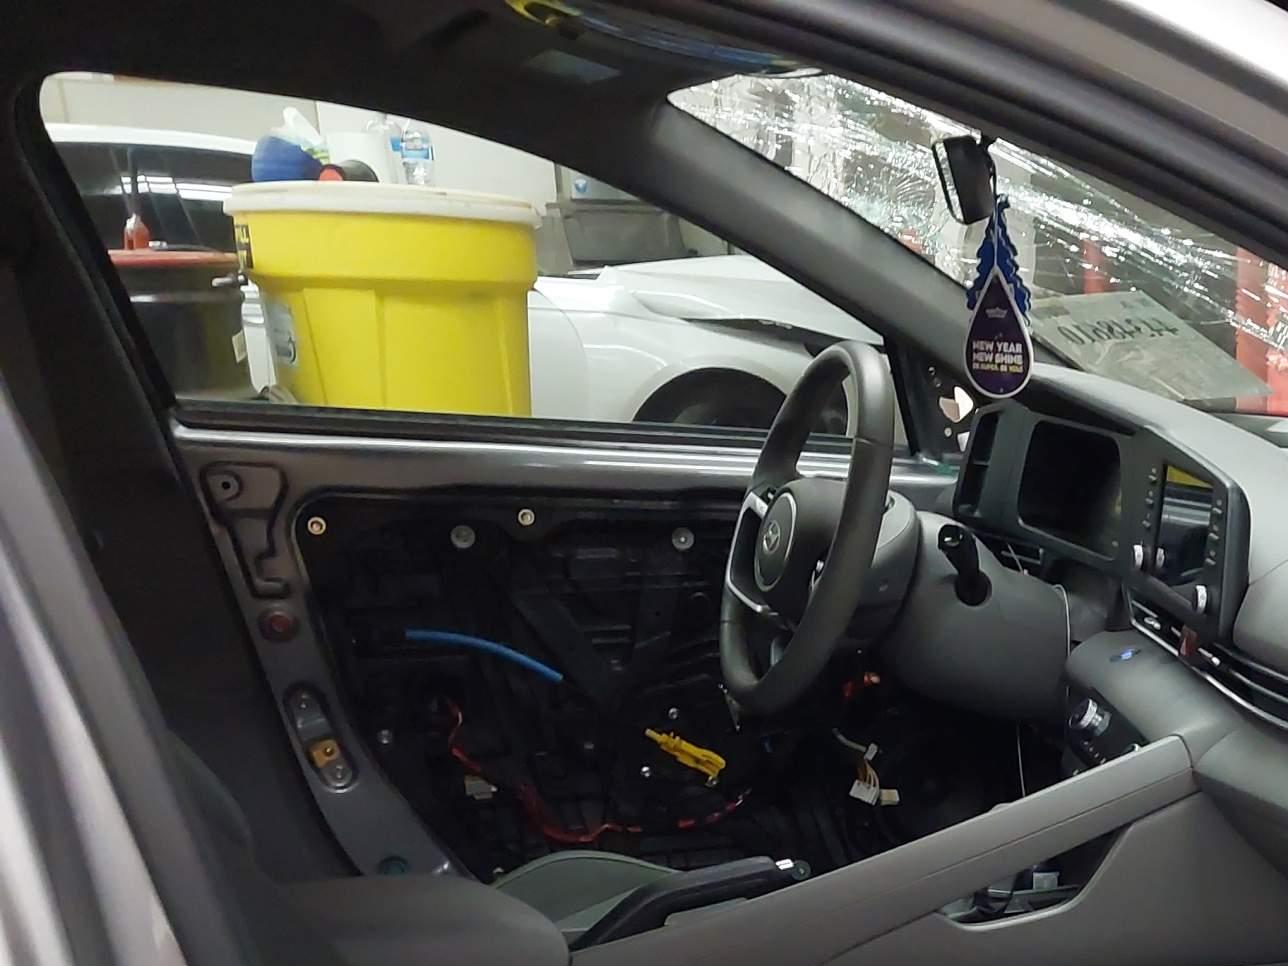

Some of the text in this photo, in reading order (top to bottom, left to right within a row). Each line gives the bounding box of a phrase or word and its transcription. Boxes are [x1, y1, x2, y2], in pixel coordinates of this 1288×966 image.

[972, 340, 1023, 353] NEW YEAR
[972, 351, 994, 363] NEW
